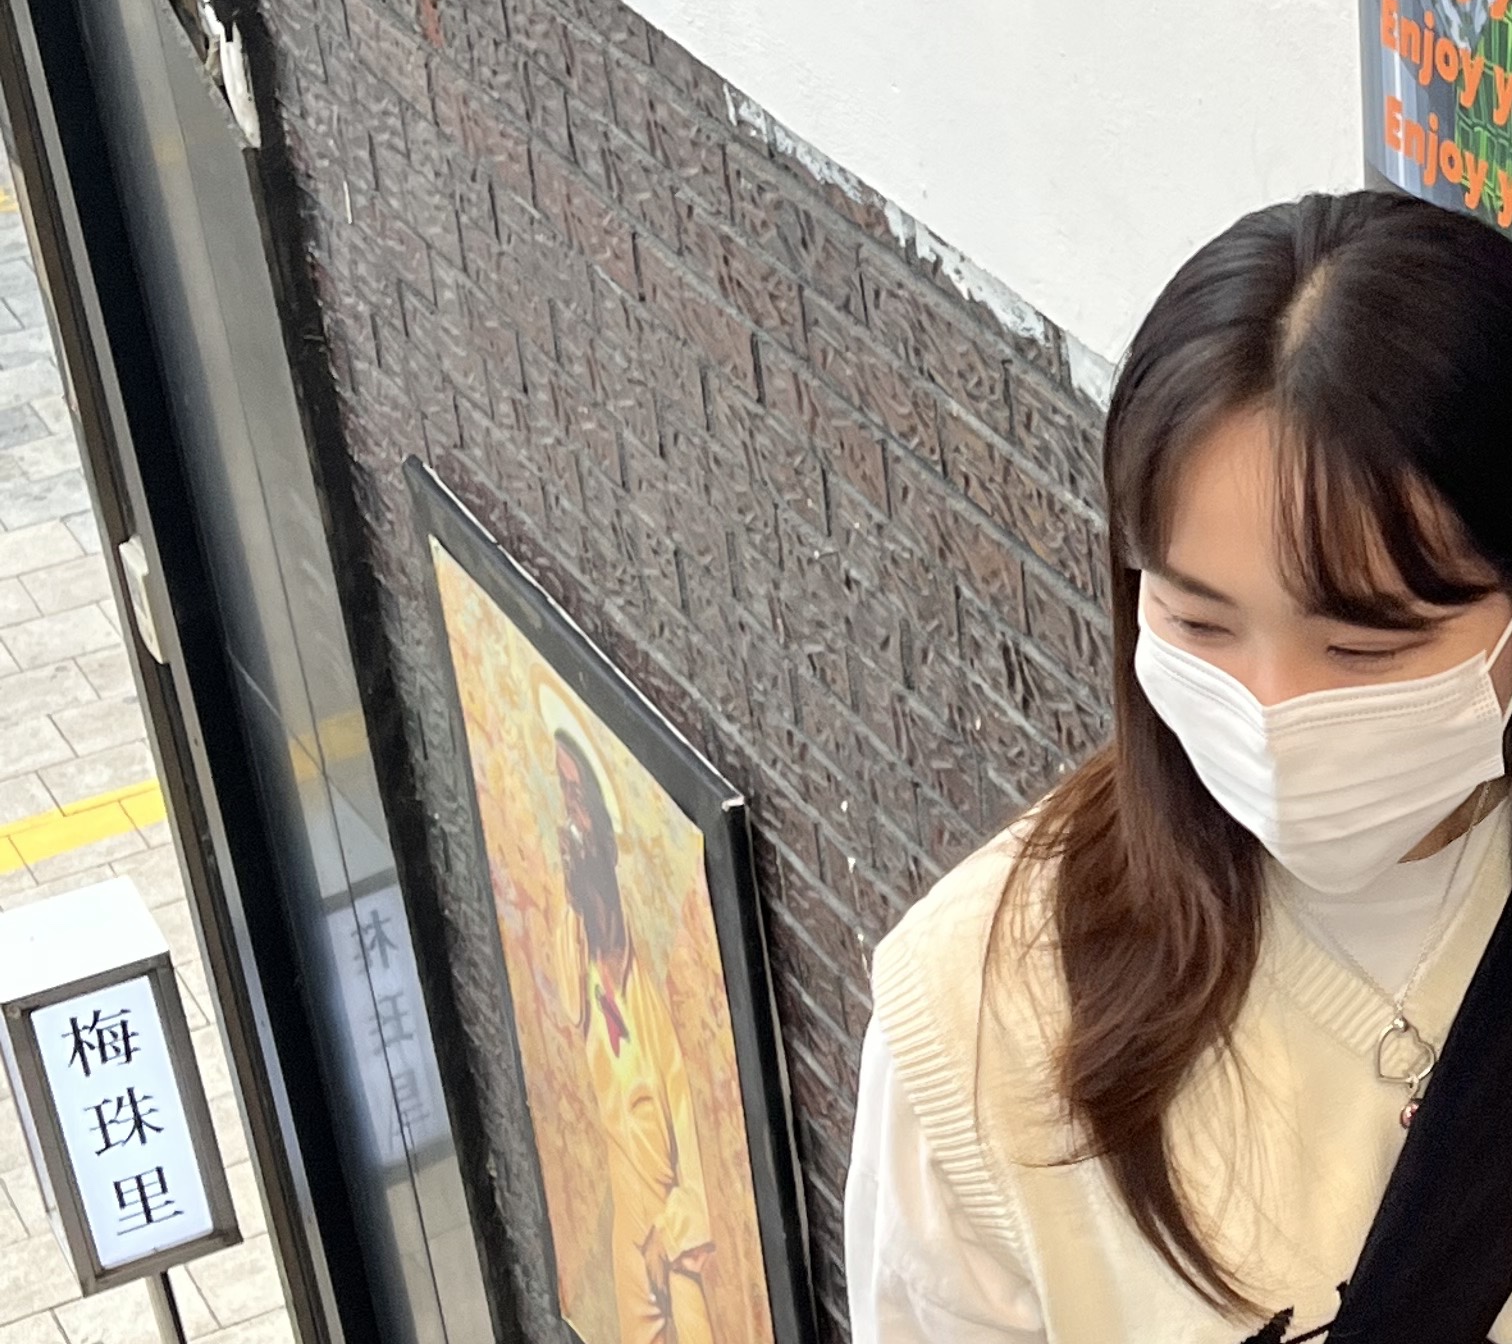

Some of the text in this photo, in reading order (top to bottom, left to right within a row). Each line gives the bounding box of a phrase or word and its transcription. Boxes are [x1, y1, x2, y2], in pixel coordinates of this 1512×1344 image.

[1383, 96, 1488, 209] Enjoy
[61, 1007, 184, 1236] 梅珠里
